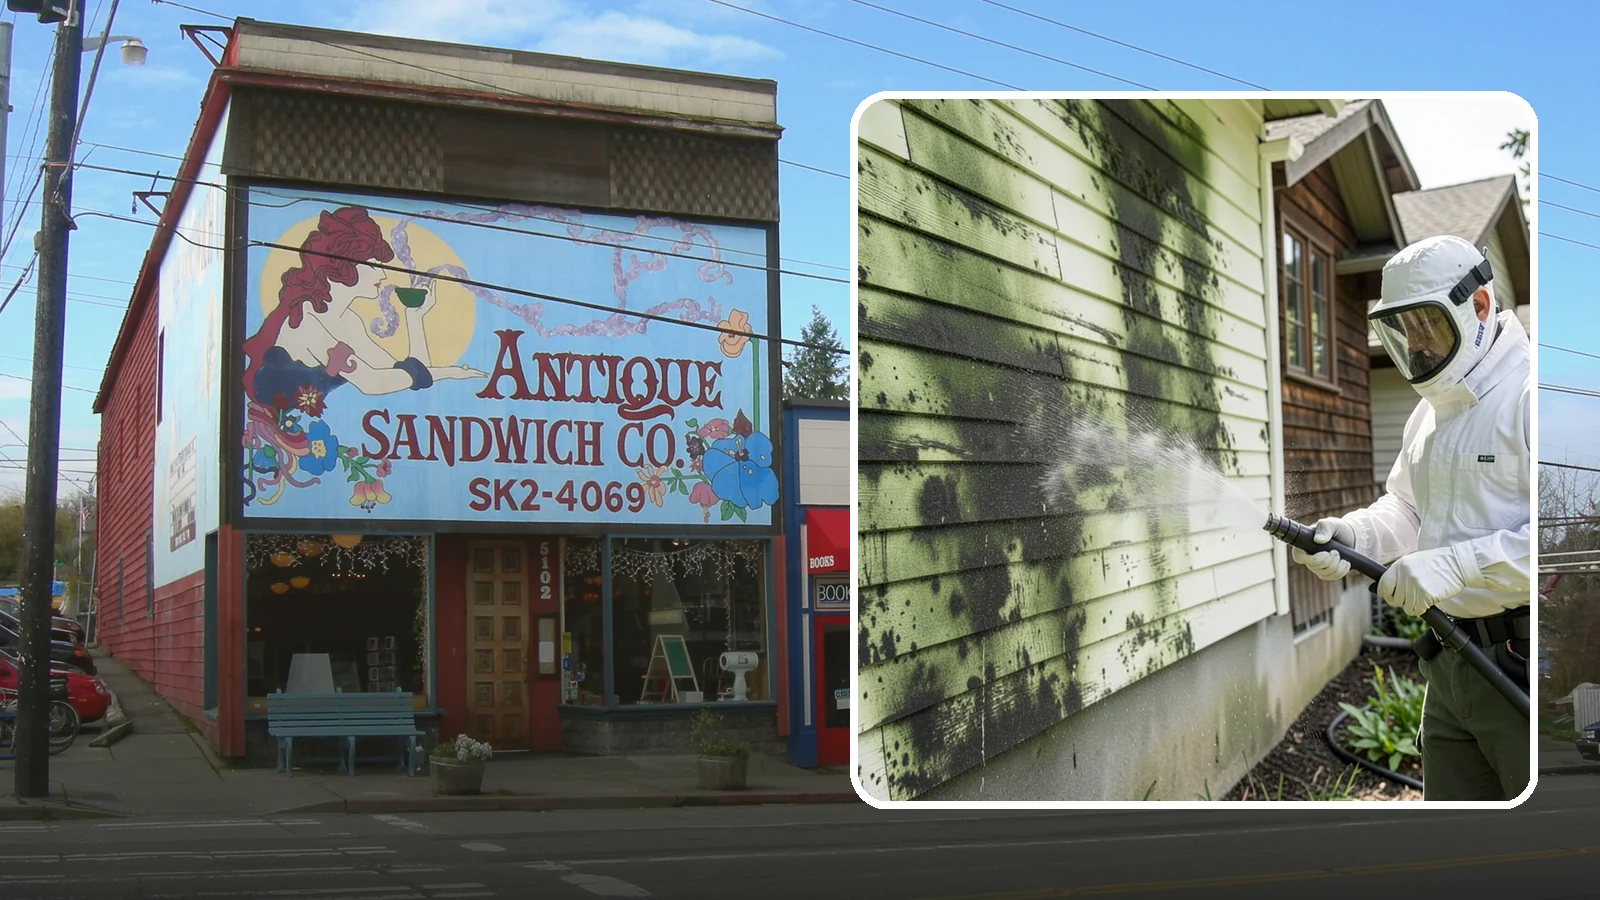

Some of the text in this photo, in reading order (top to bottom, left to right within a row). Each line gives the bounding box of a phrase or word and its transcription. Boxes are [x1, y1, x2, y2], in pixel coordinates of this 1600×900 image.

[475, 328, 723, 420] ANTIQUE
[361, 408, 685, 468] SANDWICH CO.
[468, 477, 646, 513] SK2-4069
[539, 542, 552, 600] 5102
[809, 555, 835, 569] BOOKS
